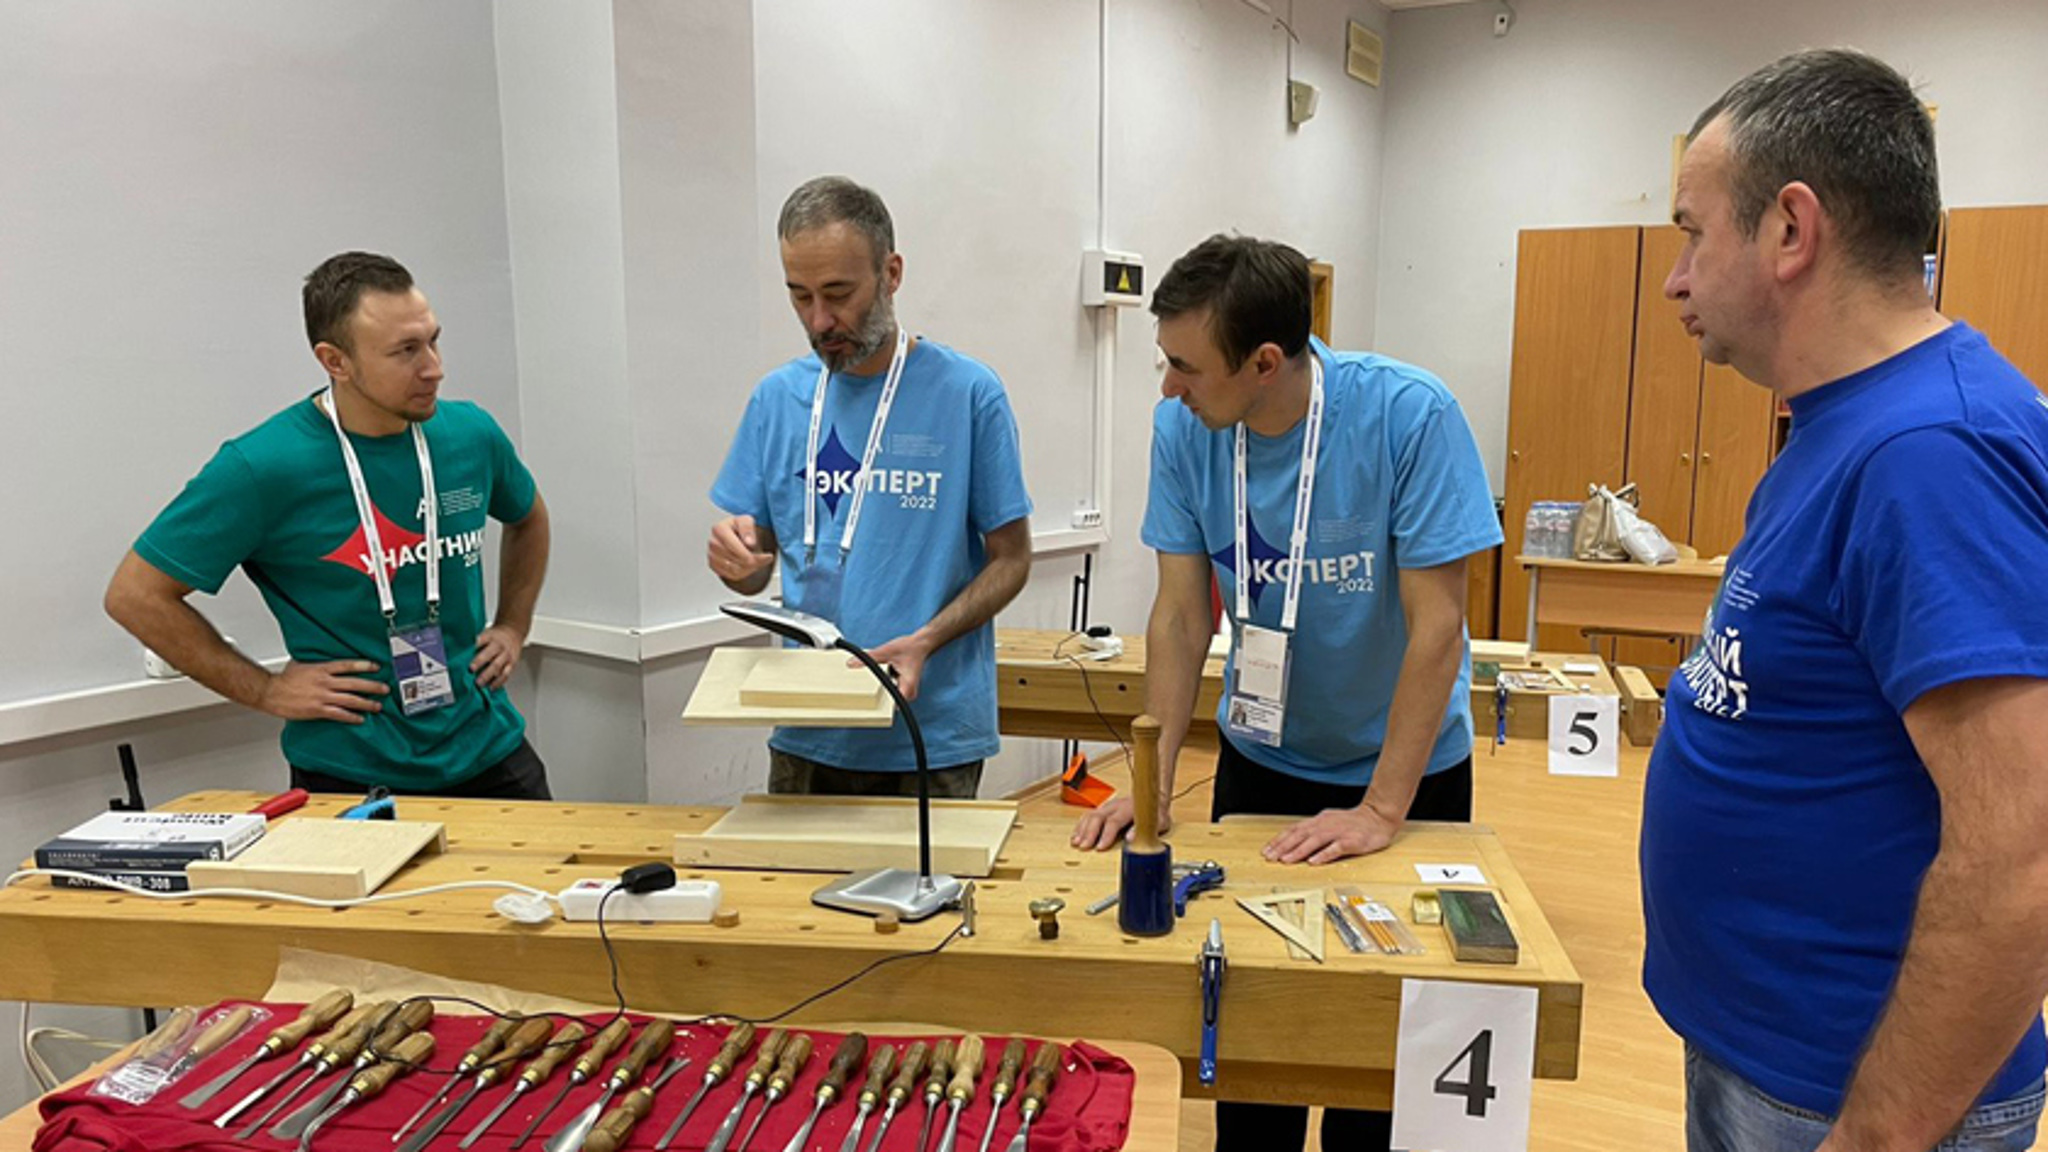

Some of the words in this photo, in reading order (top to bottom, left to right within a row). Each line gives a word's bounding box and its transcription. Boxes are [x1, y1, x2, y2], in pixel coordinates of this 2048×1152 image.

[900, 494, 938, 510] 2022
[1336, 577, 1375, 594] 2022
[1568, 711, 1598, 755] 5
[1433, 1028, 1497, 1118] 4
